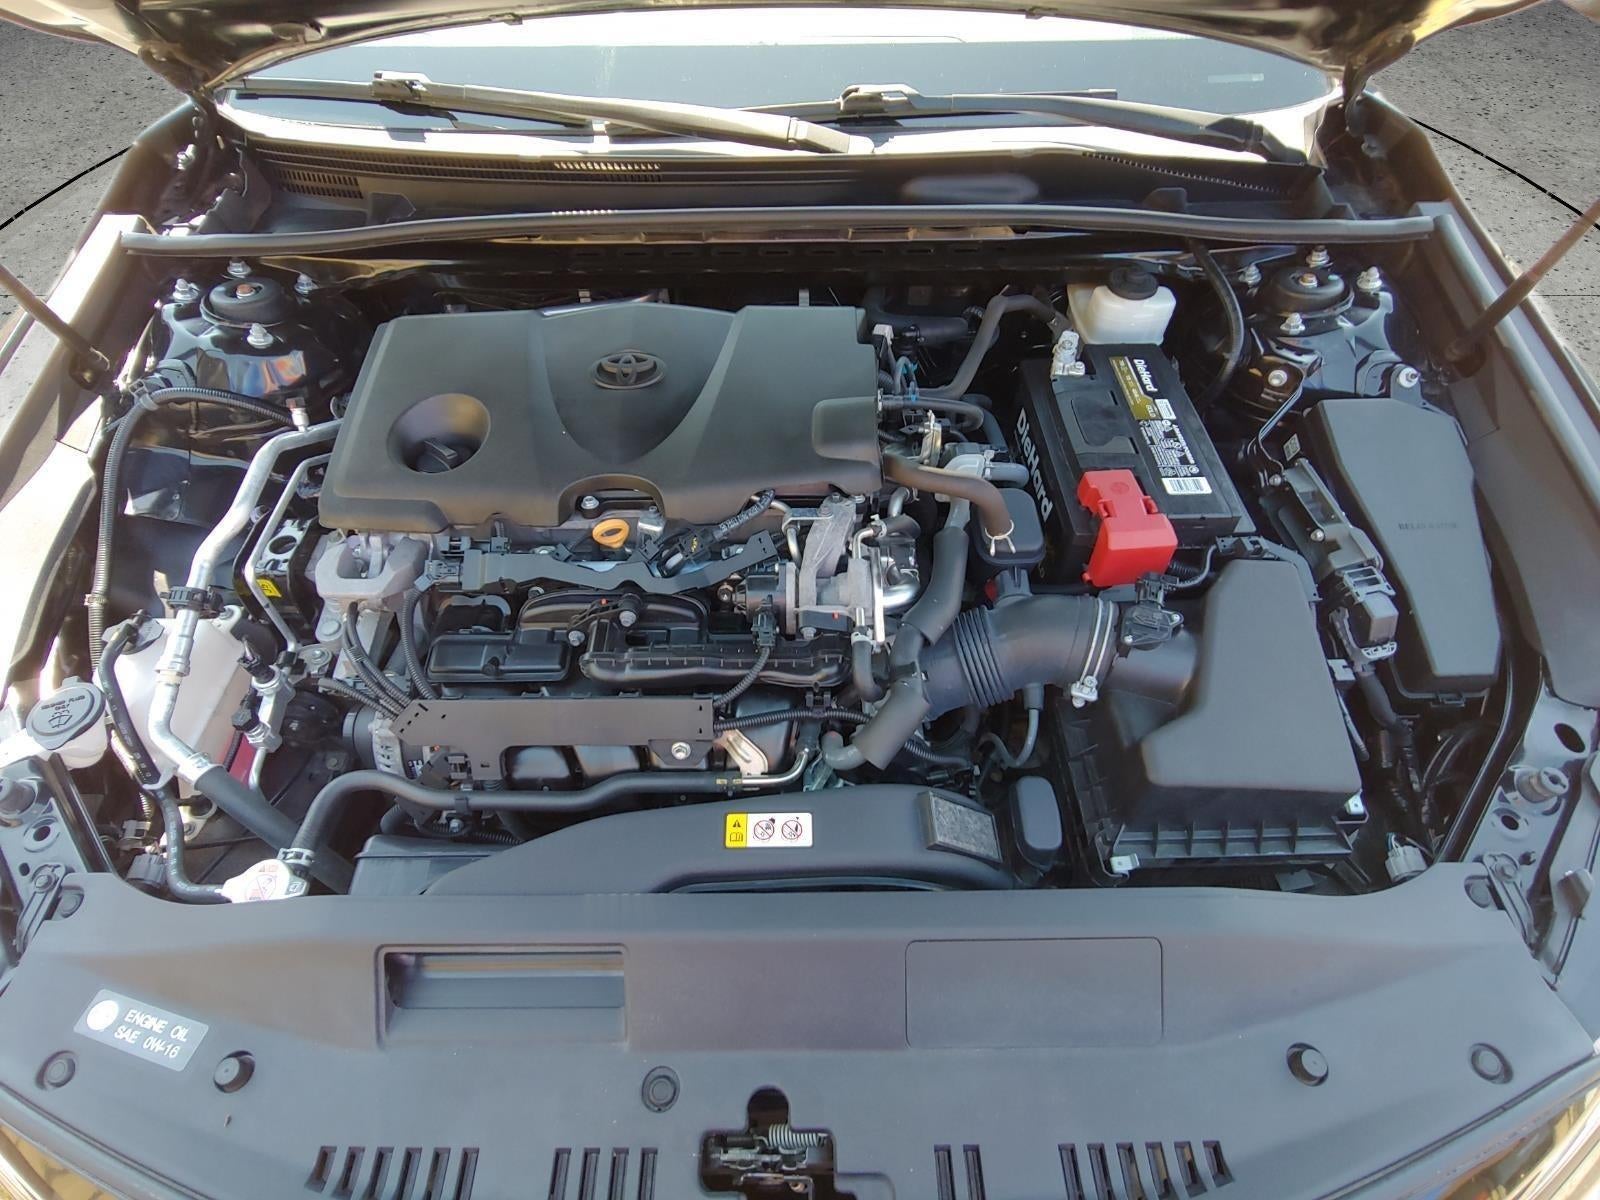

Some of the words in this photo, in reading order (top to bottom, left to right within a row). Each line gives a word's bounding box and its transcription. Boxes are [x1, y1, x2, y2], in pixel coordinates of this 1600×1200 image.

[1133, 358, 1158, 392] DieHard
[1016, 407, 1053, 522] DieHard
[114, 1025, 141, 1044] SAE
[142, 1036, 180, 1058] 0W-16
[124, 1009, 168, 1034] ENGINE
[170, 1025, 190, 1042] OIL
